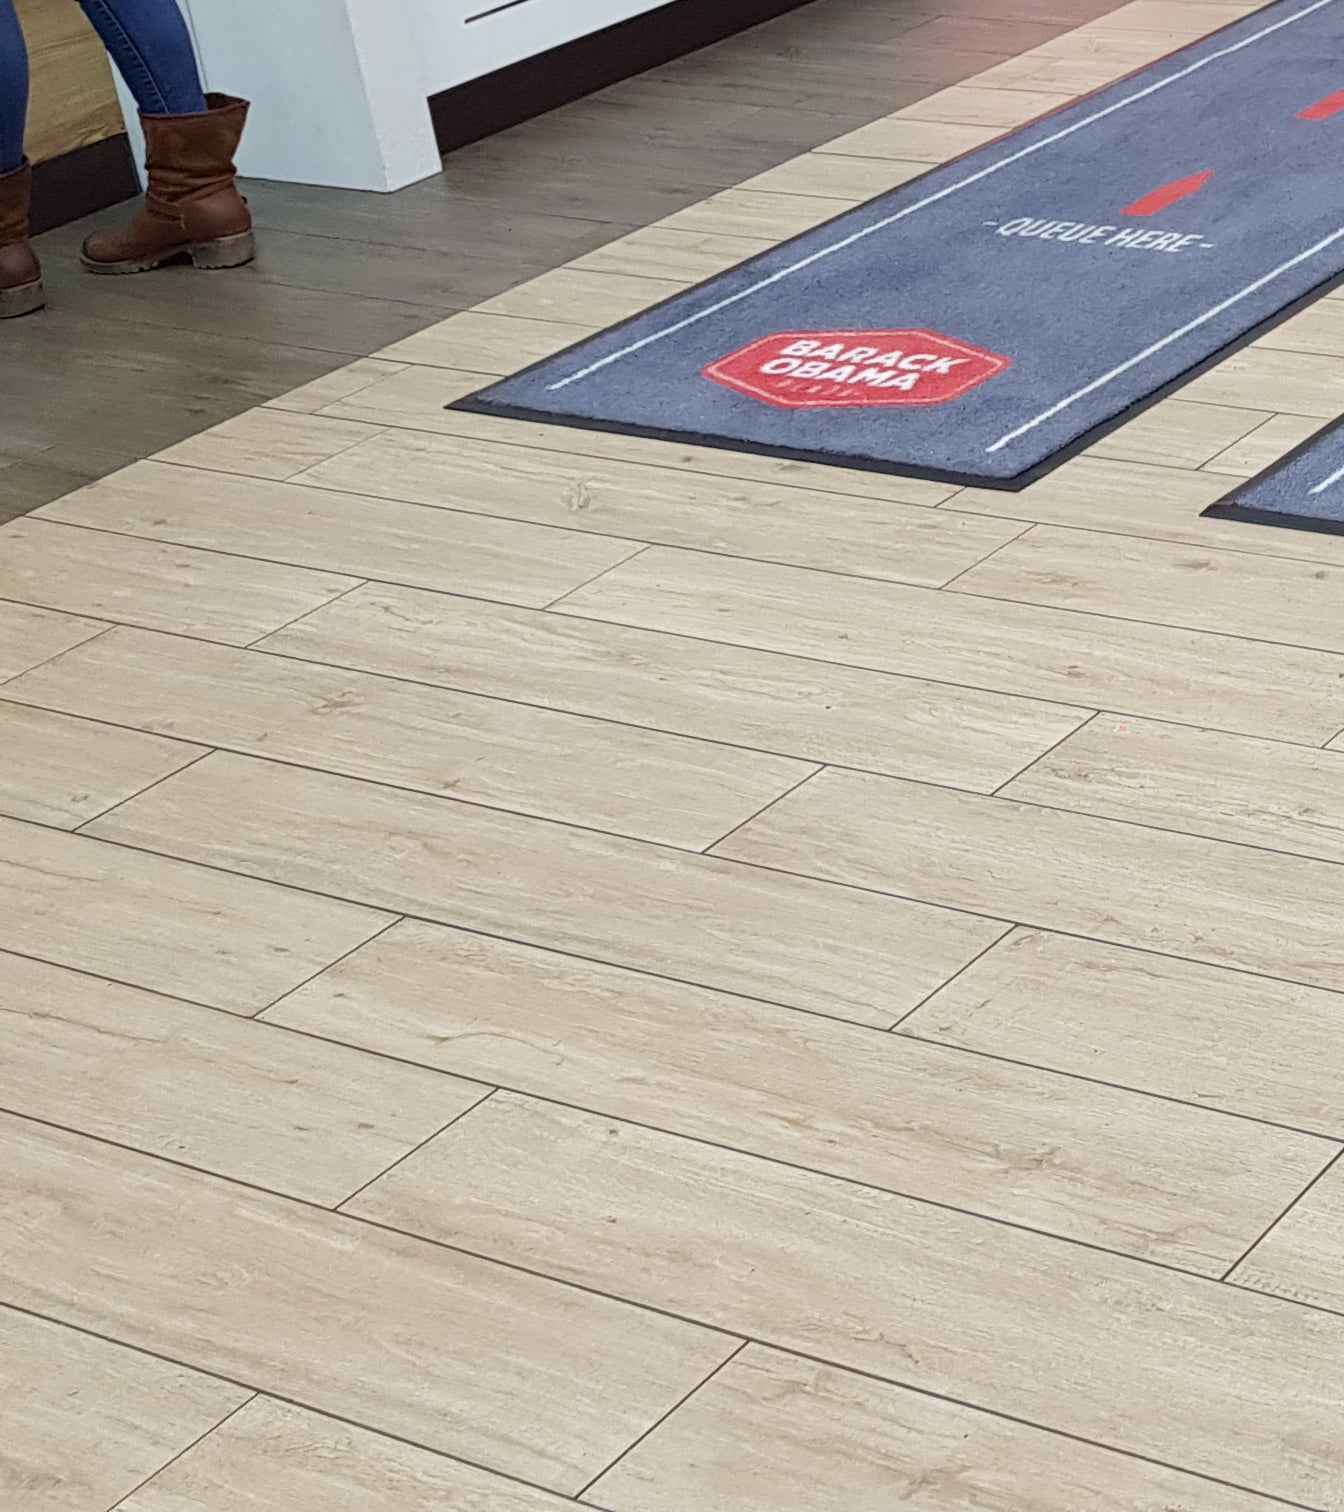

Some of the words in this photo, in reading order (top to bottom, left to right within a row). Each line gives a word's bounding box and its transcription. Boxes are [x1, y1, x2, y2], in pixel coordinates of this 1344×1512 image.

[996, 217, 1116, 244] QUEUE
[1104, 228, 1205, 253] HERE
[759, 357, 920, 391] OBAMA
[779, 339, 971, 374] BARACK
